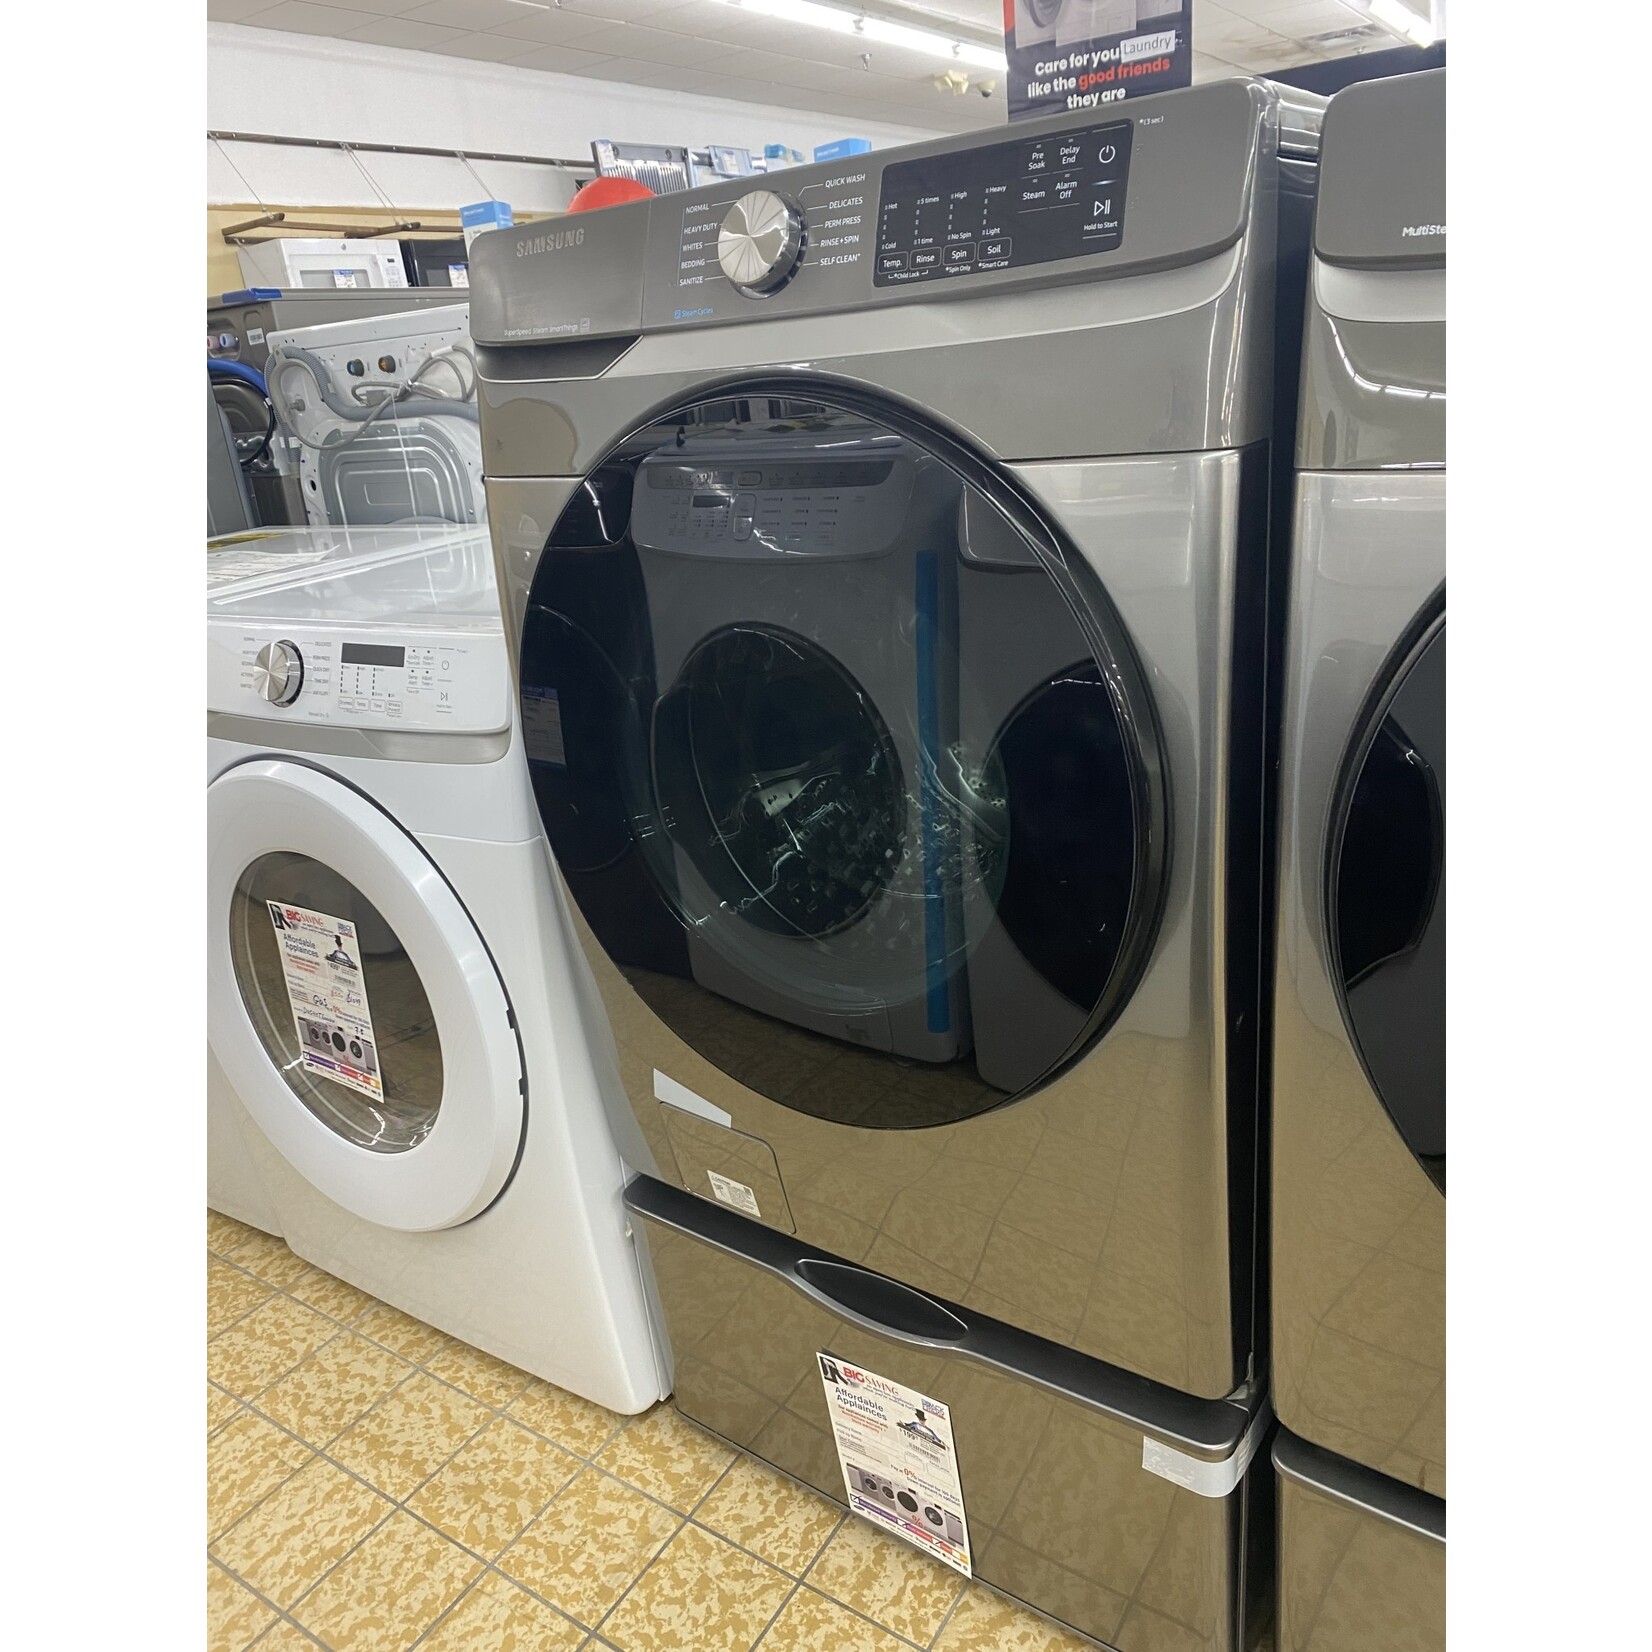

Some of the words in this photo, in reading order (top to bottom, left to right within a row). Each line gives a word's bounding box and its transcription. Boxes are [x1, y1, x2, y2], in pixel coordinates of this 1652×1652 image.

[1035, 57, 1068, 76] Care
[1069, 53, 1090, 69] for
[1123, 34, 1172, 55] Laundry
[1027, 78, 1051, 98] like
[1053, 75, 1077, 92] the
[1078, 67, 1115, 91] good
[1117, 56, 1171, 79] friends
[1066, 91, 1099, 110] they
[1101, 86, 1127, 102] are
[1032, 152, 1044, 160] Pre
[1060, 146, 1080, 156] Delay
[1062, 155, 1076, 164] End
[1028, 161, 1045, 170] Soak
[825, 177, 846, 189] QUICK
[846, 173, 866, 184] WASH
[1055, 181, 1078, 190] Alarm
[989, 185, 1007, 193] Heavy
[954, 191, 968, 199] High
[1022, 190, 1046, 200] Steam
[1060, 190, 1072, 199] Off
[829, 196, 864, 209] DELICATES
[685, 203, 710, 214] NORMAL
[824, 218, 842, 229] PERM
[842, 215, 862, 226] PRESS
[1084, 223, 1097, 231] Hold
[1104, 221, 1118, 229] Start
[684, 225, 702, 235] HEAVY
[703, 222, 718, 232] DUTY
[986, 228, 1001, 236] Light
[960, 232, 972, 240] Spin
[516, 228, 585, 257] SAMSUNG
[683, 242, 703, 251] WHITES
[885, 242, 896, 250] Cold
[987, 245, 1001, 254] Soil
[916, 254, 935, 263] Rinse
[951, 250, 967, 260] Spin
[681, 258, 706, 269] BEDDING
[820, 256, 836, 266] SELF
[883, 260, 902, 269] Temp.
[959, 264, 971, 272] Only
[680, 276, 704, 286] SANITIZE
[504, 327, 532, 337] SuperSpeed
[532, 326, 549, 335] Steam
[549, 323, 578, 335] SmartThings
[284, 933, 316, 949] Affordable
[843, 1367, 865, 1383] BIG
[865, 1375, 899, 1396] SAVING
[835, 1387, 884, 1412] Affordable
[903, 1468, 917, 1480] 0%
